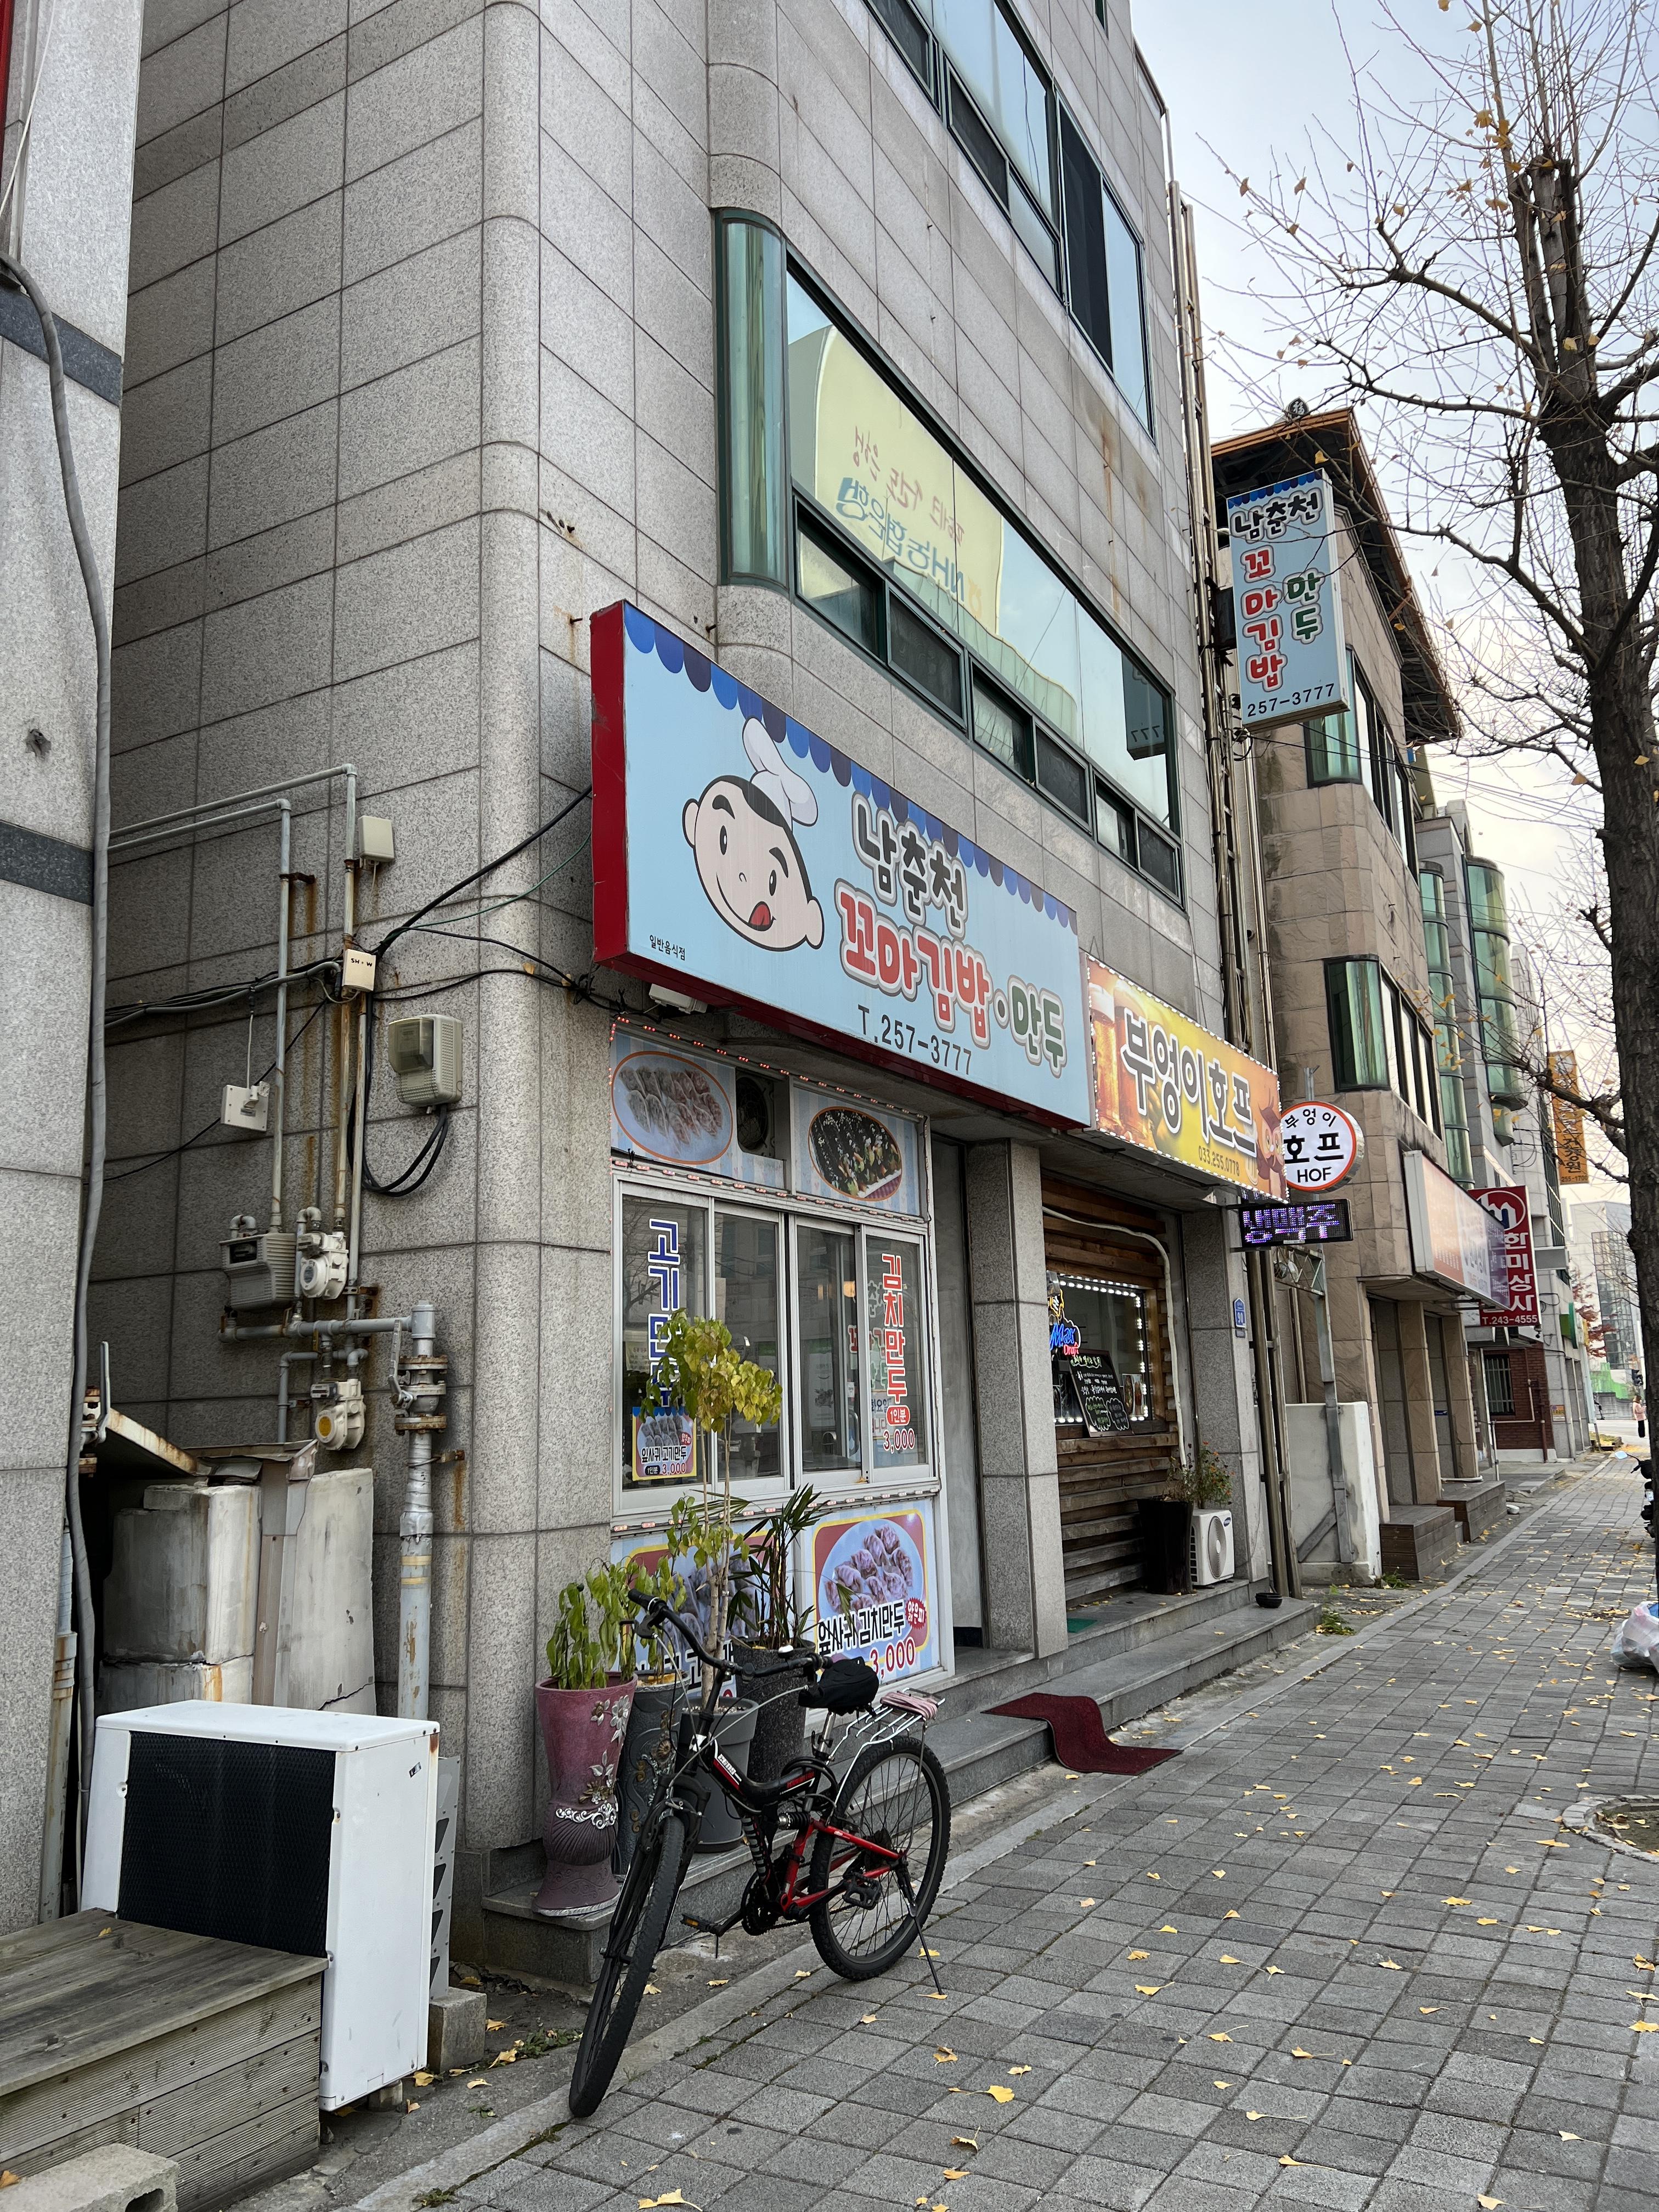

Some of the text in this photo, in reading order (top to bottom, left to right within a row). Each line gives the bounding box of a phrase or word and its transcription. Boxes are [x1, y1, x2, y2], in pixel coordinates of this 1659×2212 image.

[1233, 489, 1321, 540] 남춘천
[1242, 548, 1285, 690] 꼬마김밥
[1286, 571, 1322, 642] 만두
[1247, 684, 1335, 717] 257-3777
[853, 794, 966, 935] 남춘천
[650, 935, 685, 961] 일반음식점
[1120, 1007, 1257, 1157] 부엉이호프
[1285, 1108, 1336, 1128] 부엉이
[1199, 1146, 1240, 1176] 033.255.0778
[1284, 1132, 1344, 1164] 호프
[1297, 1166, 1332, 1183] HOF
[1504, 1232, 1534, 1311] 한미상사
[882, 1254, 907, 1403] 김치만두
[1237, 1312, 1244, 1323] 90
[1482, 1314, 1538, 1325] T.243-4555
[890, 1408, 906, 1423] 1인분
[663, 1446, 686, 1461] 고기만두
[883, 1429, 915, 1454] 3,000
[662, 1463, 686, 1475] 3,000
[859, 1602, 904, 1645] 김치만두
[907, 1601, 925, 1624] 얇은피
